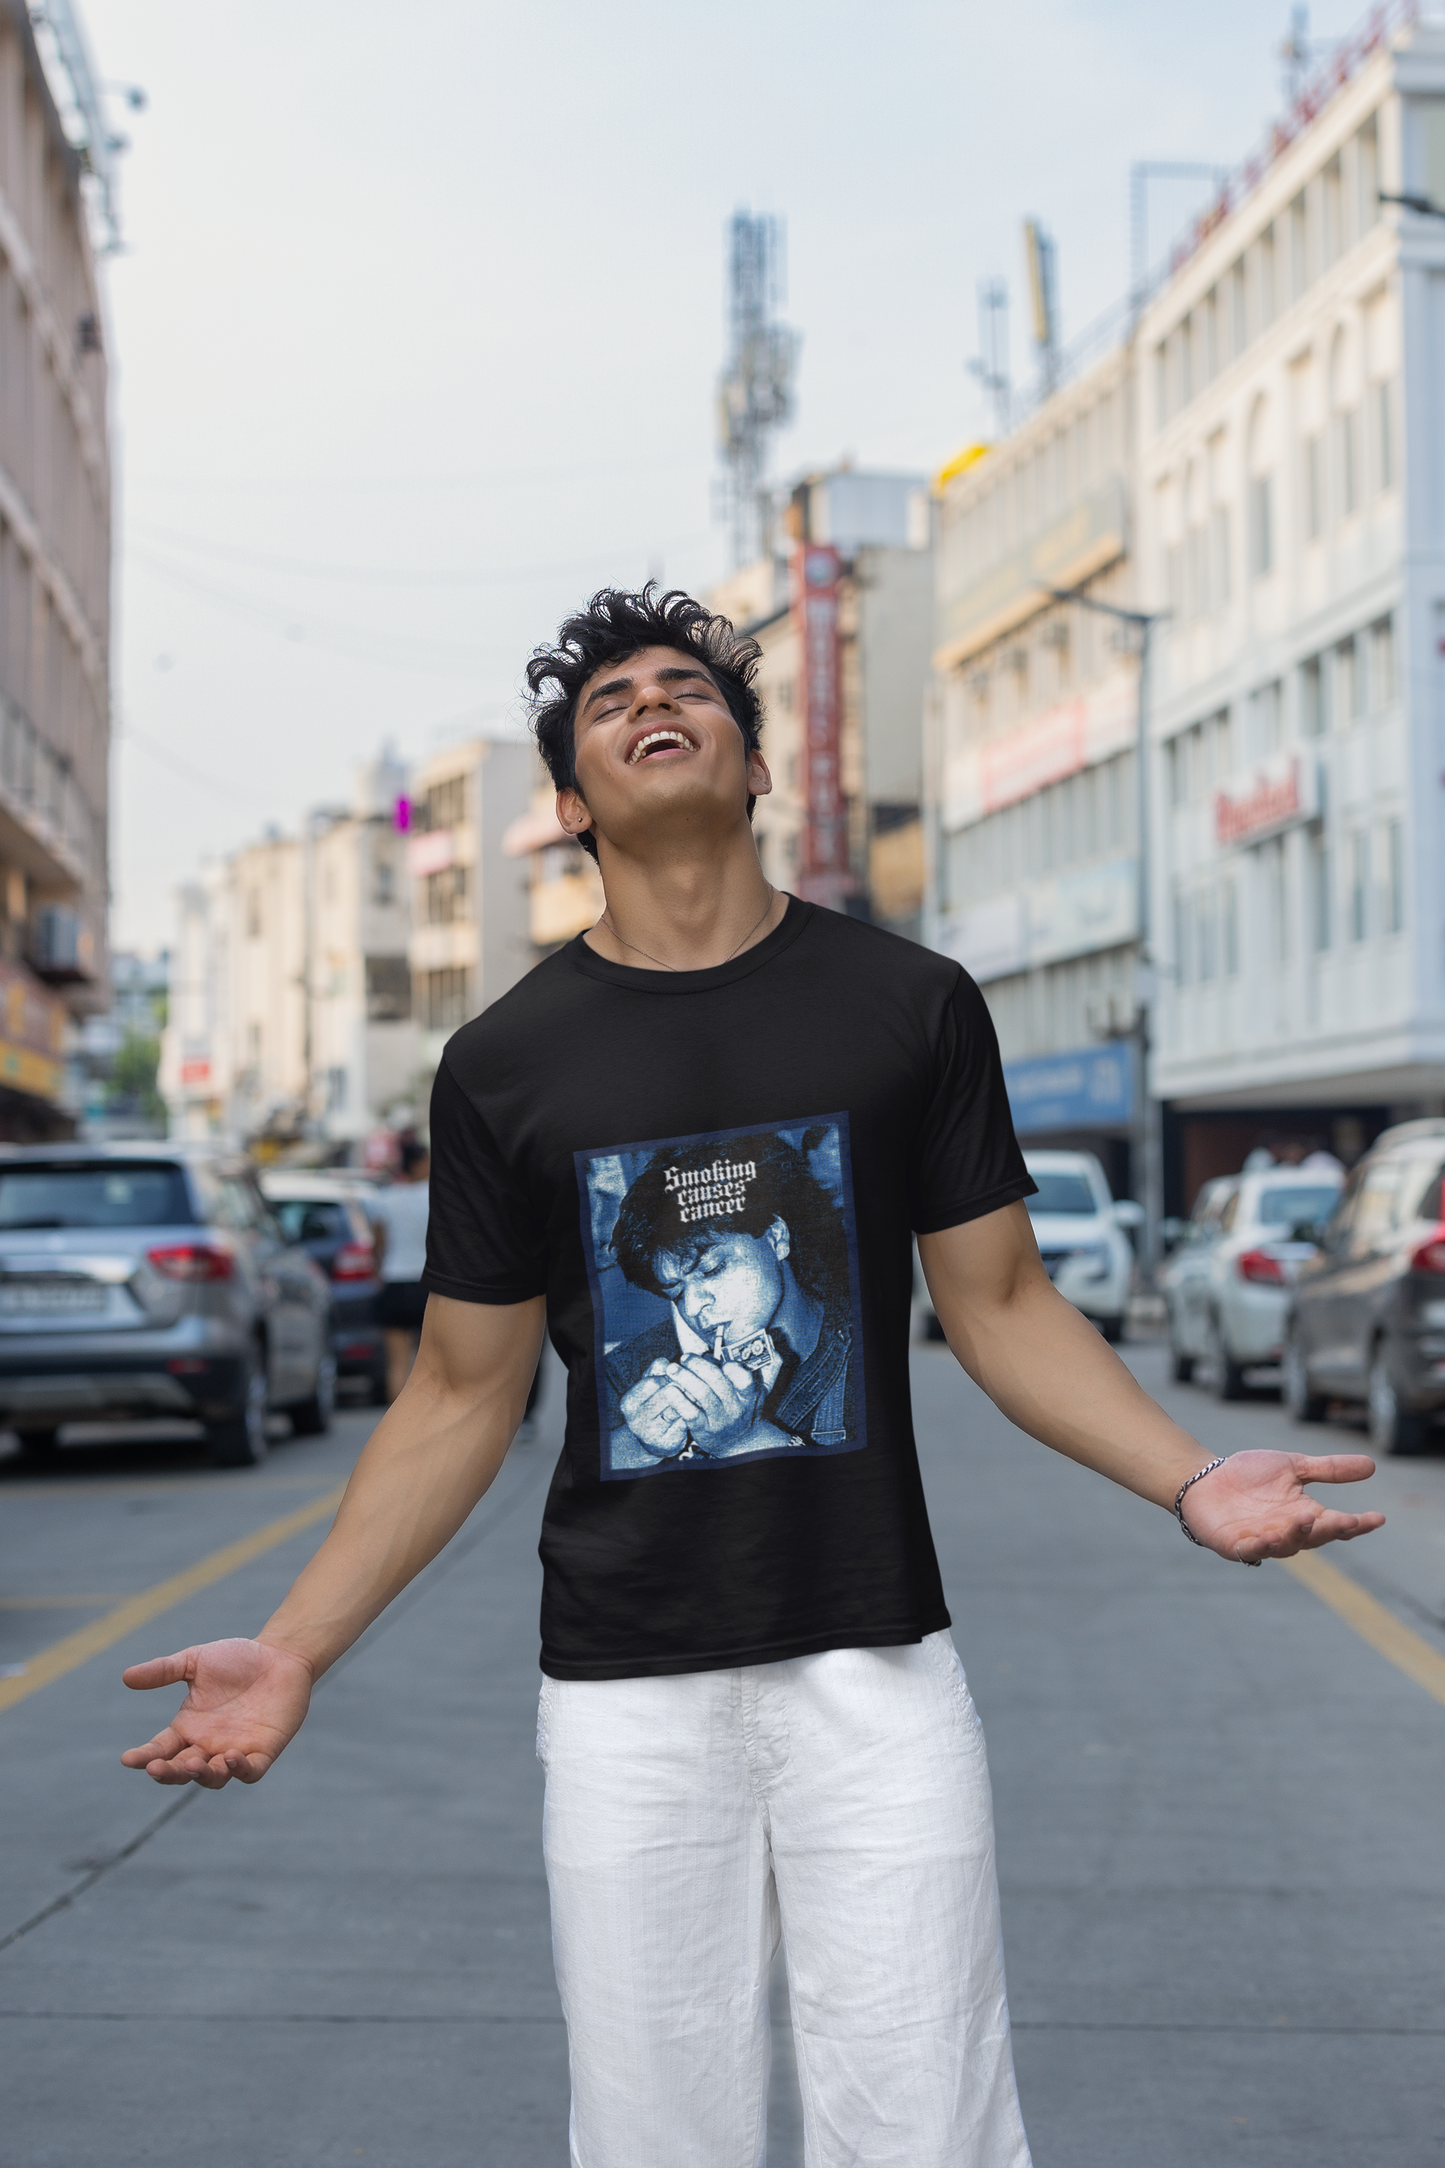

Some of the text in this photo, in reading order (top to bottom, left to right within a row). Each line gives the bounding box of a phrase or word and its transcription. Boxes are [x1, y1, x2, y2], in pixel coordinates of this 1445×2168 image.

[663, 1159, 757, 1194] Smoking
[677, 1179, 746, 1207] causes
[679, 1196, 746, 1223] cancer
